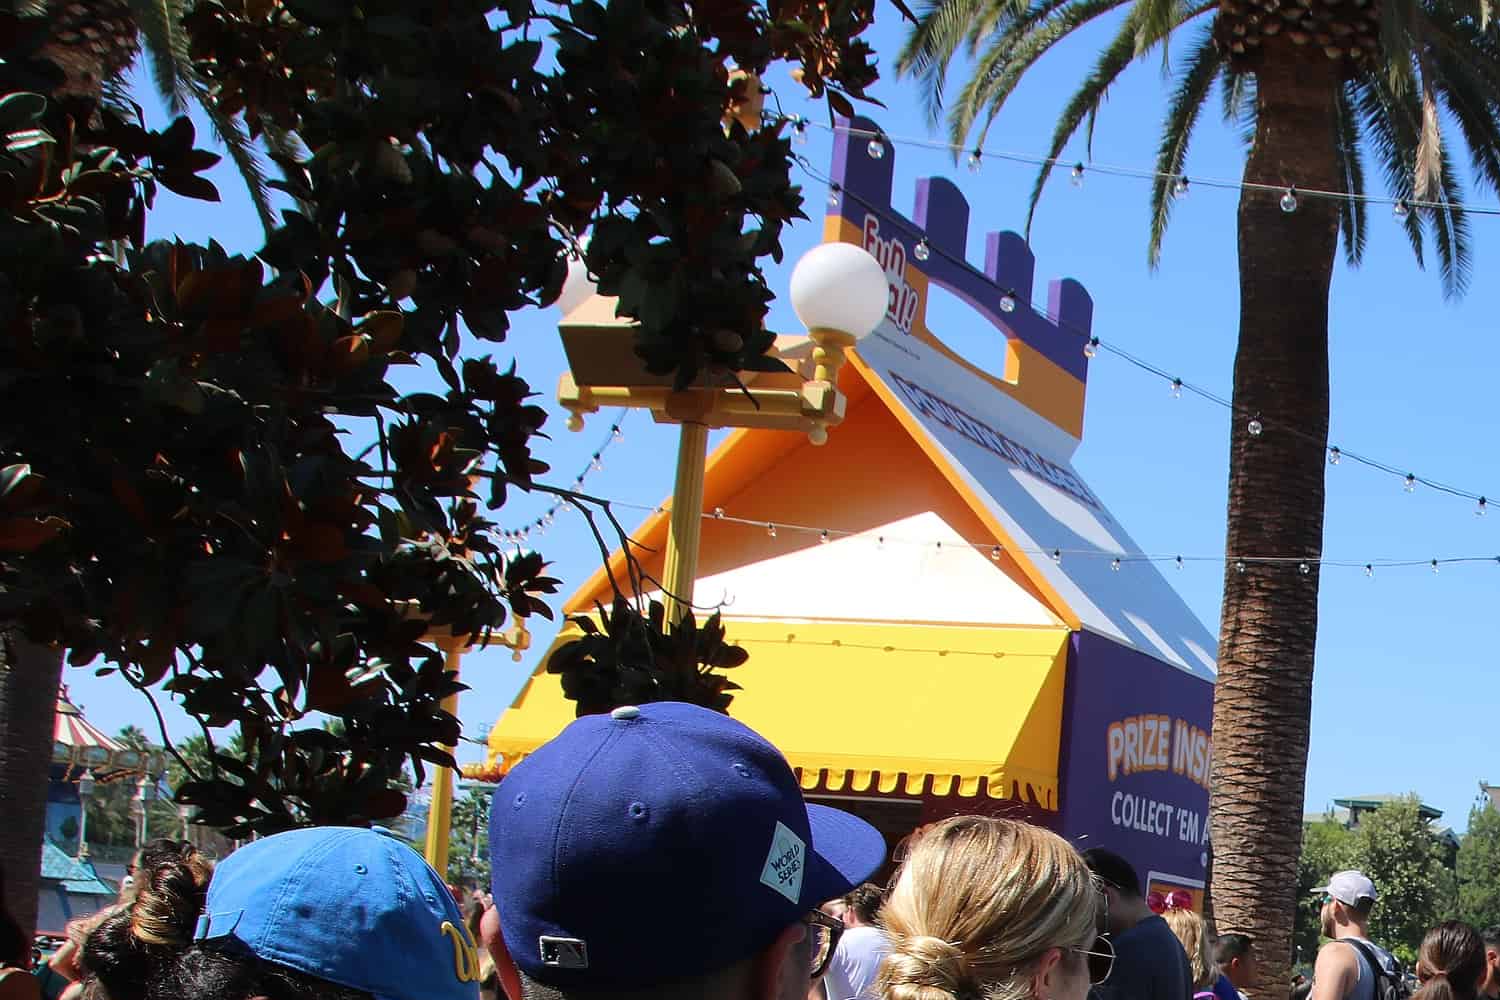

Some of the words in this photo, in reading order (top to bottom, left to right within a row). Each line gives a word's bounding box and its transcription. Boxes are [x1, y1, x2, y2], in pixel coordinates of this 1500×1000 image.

[1107, 715, 1171, 782] PRIZE
[1172, 718, 1213, 789] INSI
[1111, 791, 1173, 835] COLLECT
[770, 844, 800, 871] WORLD
